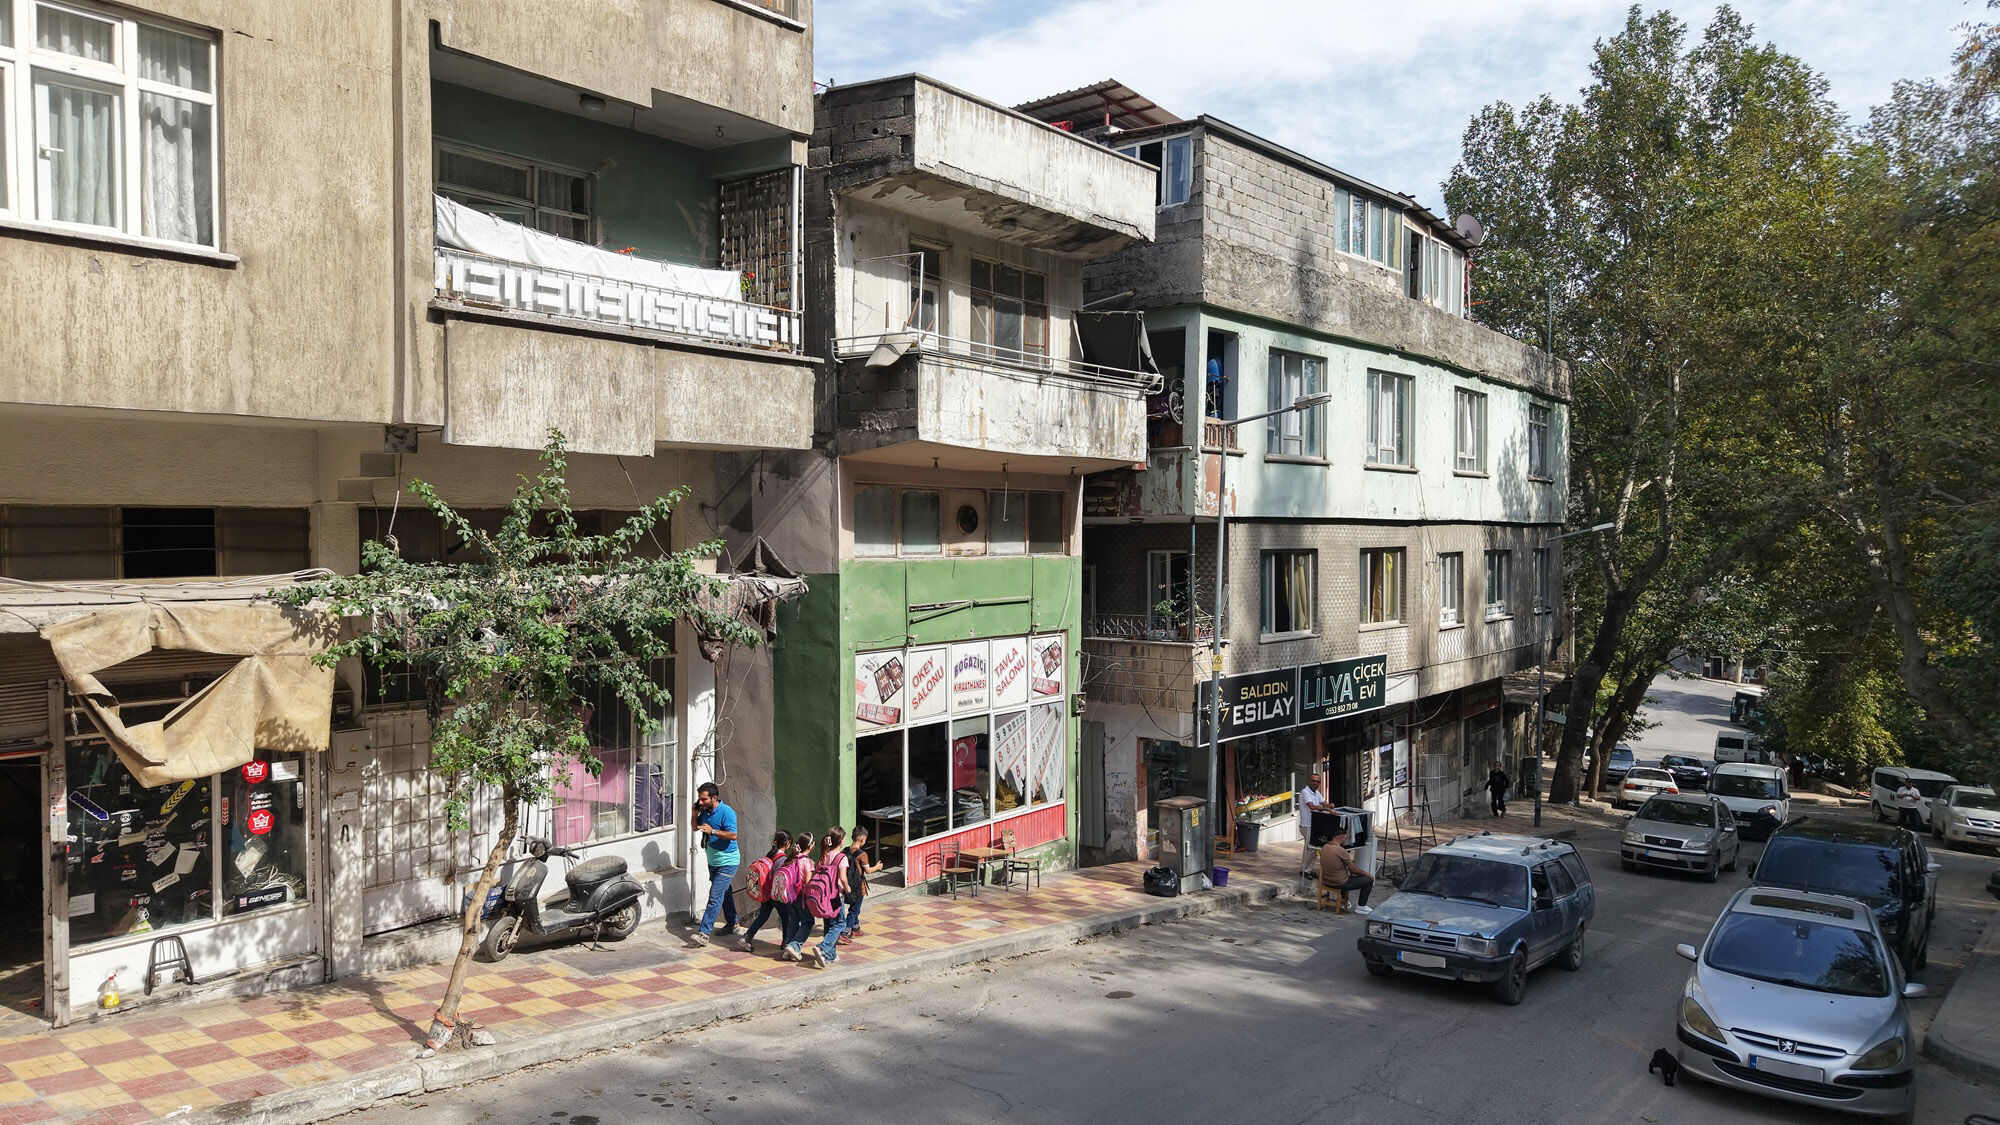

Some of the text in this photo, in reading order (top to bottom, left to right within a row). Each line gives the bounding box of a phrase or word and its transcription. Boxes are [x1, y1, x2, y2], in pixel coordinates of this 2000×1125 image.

[912, 656, 934, 688] OKEY
[954, 653, 987, 678] BOĞAZİÇİ
[994, 648, 1018, 677] TAVLA
[1353, 662, 1384, 683] ÇİÇEK
[911, 665, 945, 709] SALONU
[995, 657, 1025, 696] SALONU
[1240, 681, 1289, 700] SALOON
[1359, 681, 1377, 700] EVİ
